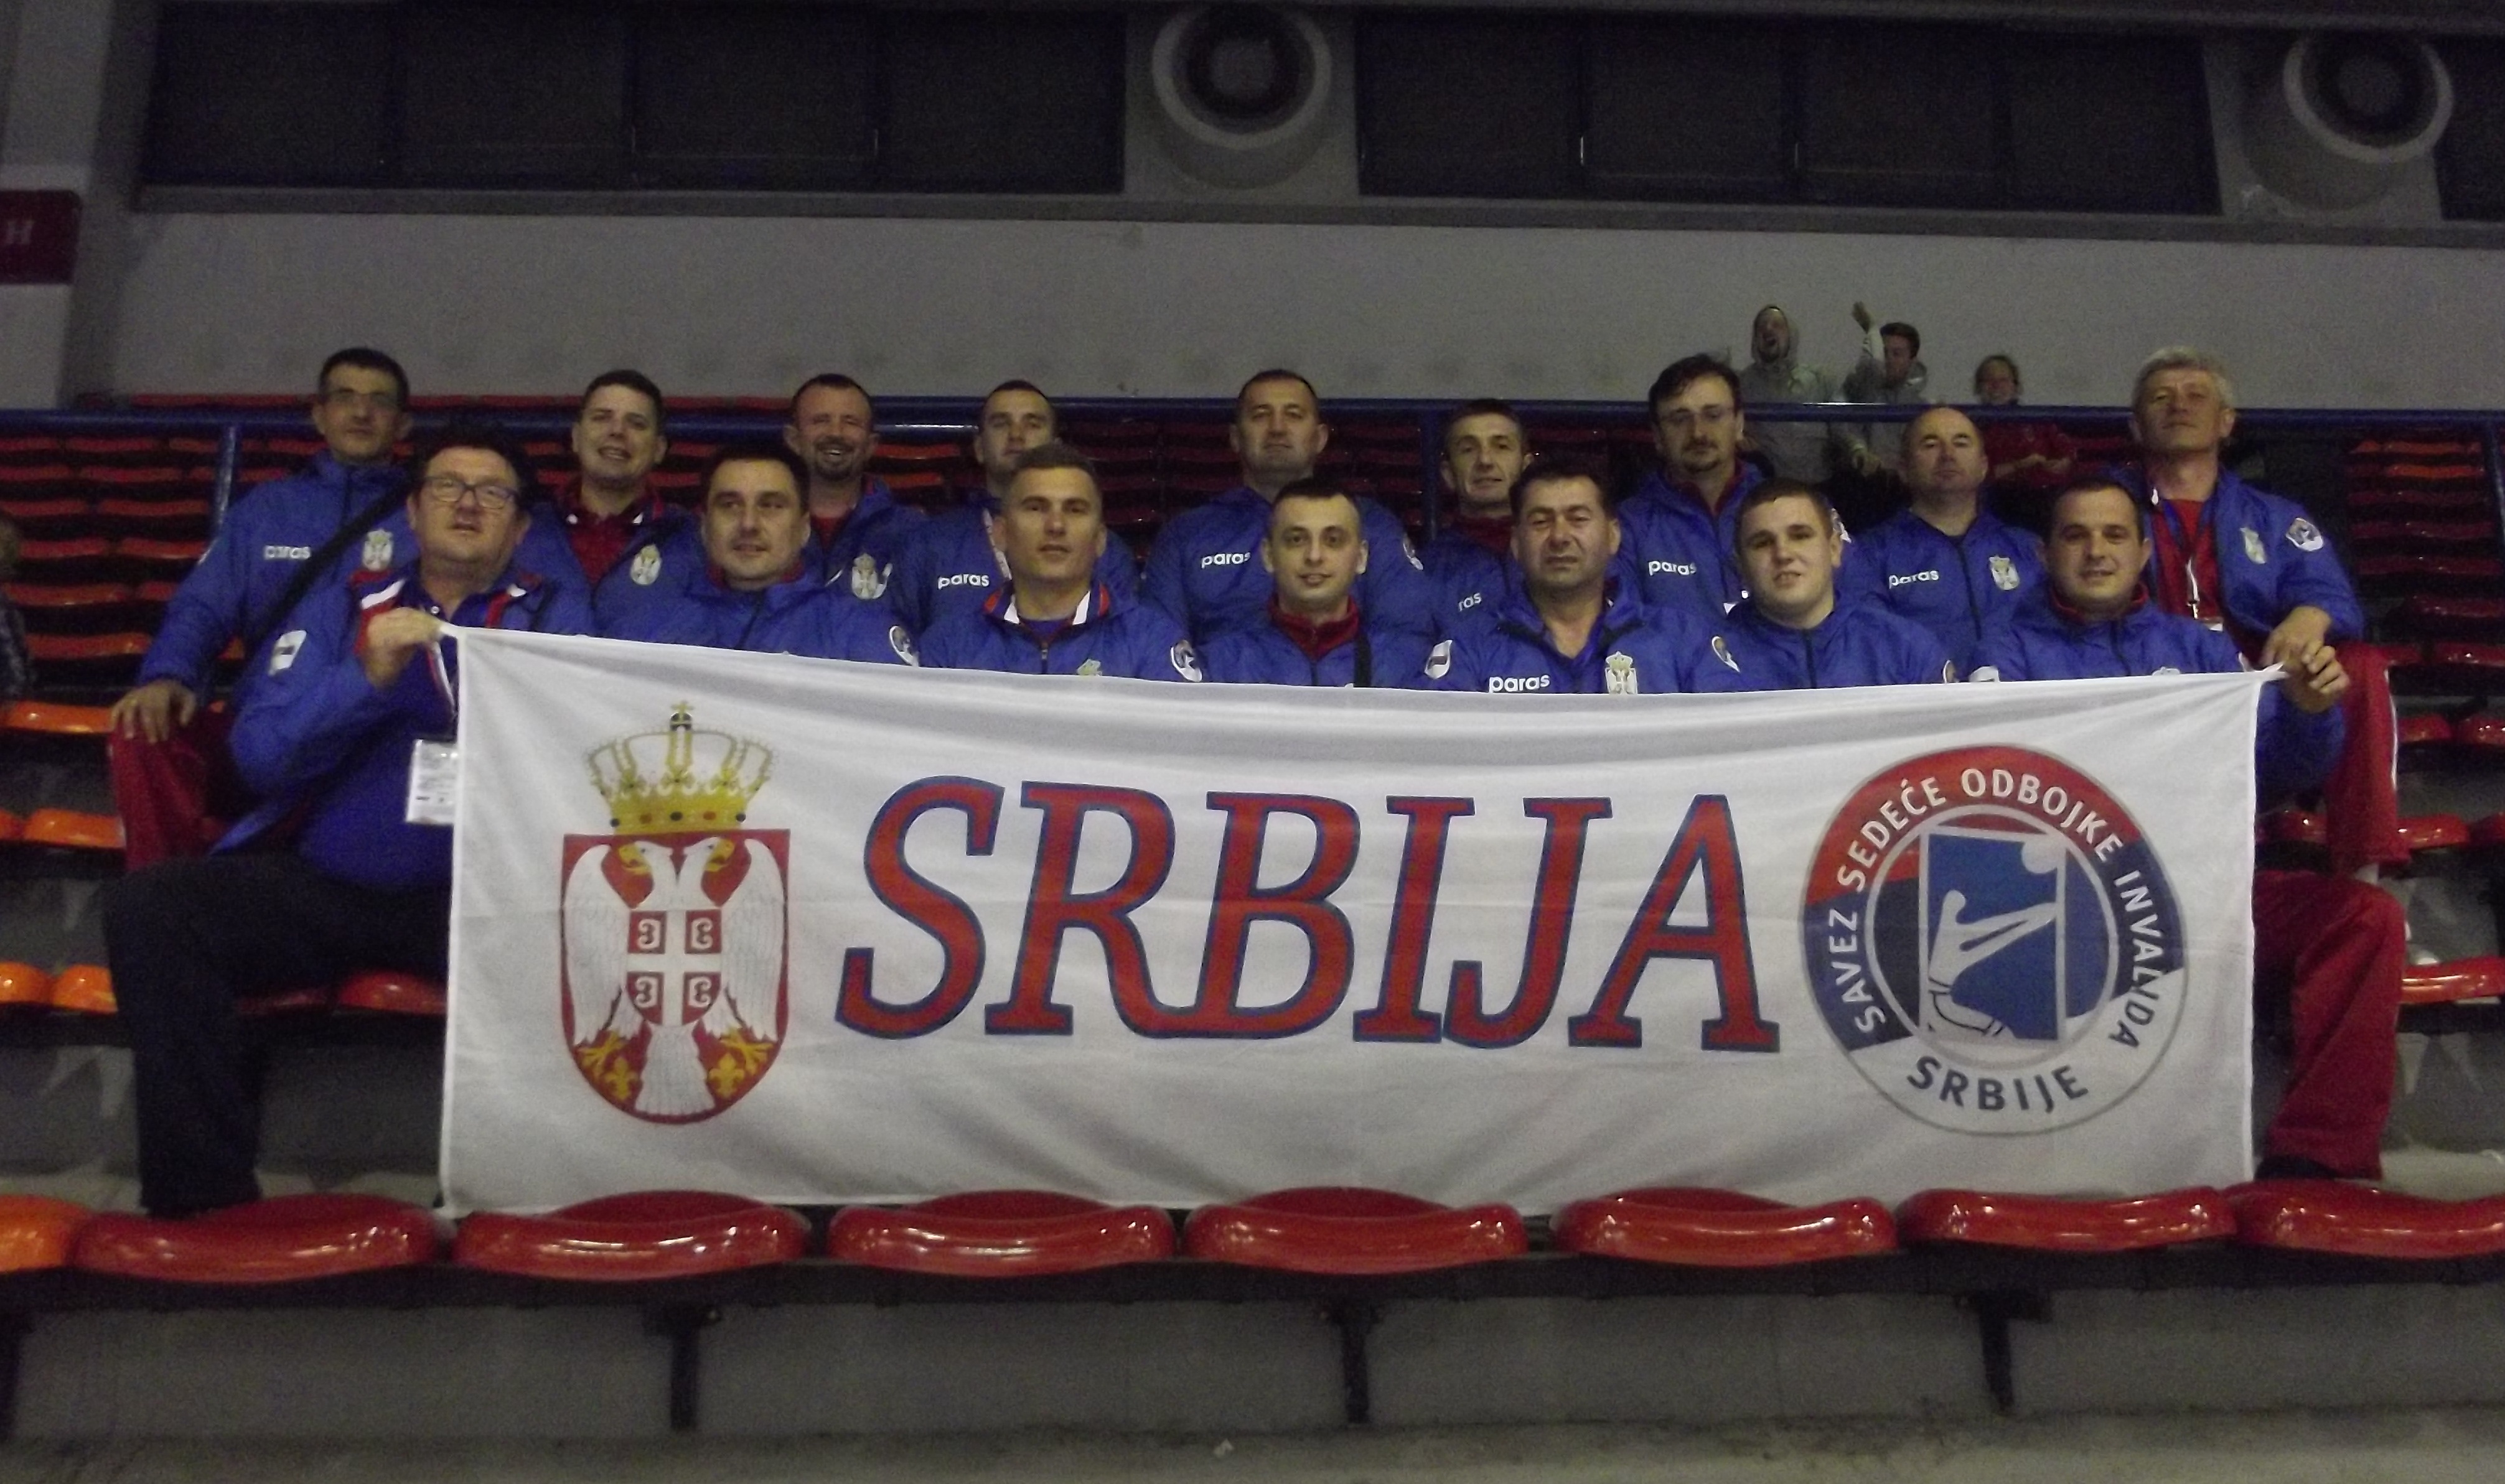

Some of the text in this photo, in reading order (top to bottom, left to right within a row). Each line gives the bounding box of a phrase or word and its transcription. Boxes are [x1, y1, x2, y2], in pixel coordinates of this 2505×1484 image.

[1201, 552, 1251, 569] paras
[1648, 561, 1697, 576] paras
[938, 574, 990, 589] paras
[1889, 570, 1939, 590] paras
[1458, 592, 1482, 612] ras
[1489, 674, 1550, 694] paras
[835, 775, 1781, 1053] SRBIJA
[1828, 768, 2165, 1048] SAVEZ SEDEĆE ODBOJKE INVALIDA
[1907, 1055, 2089, 1114] SRBIJE
